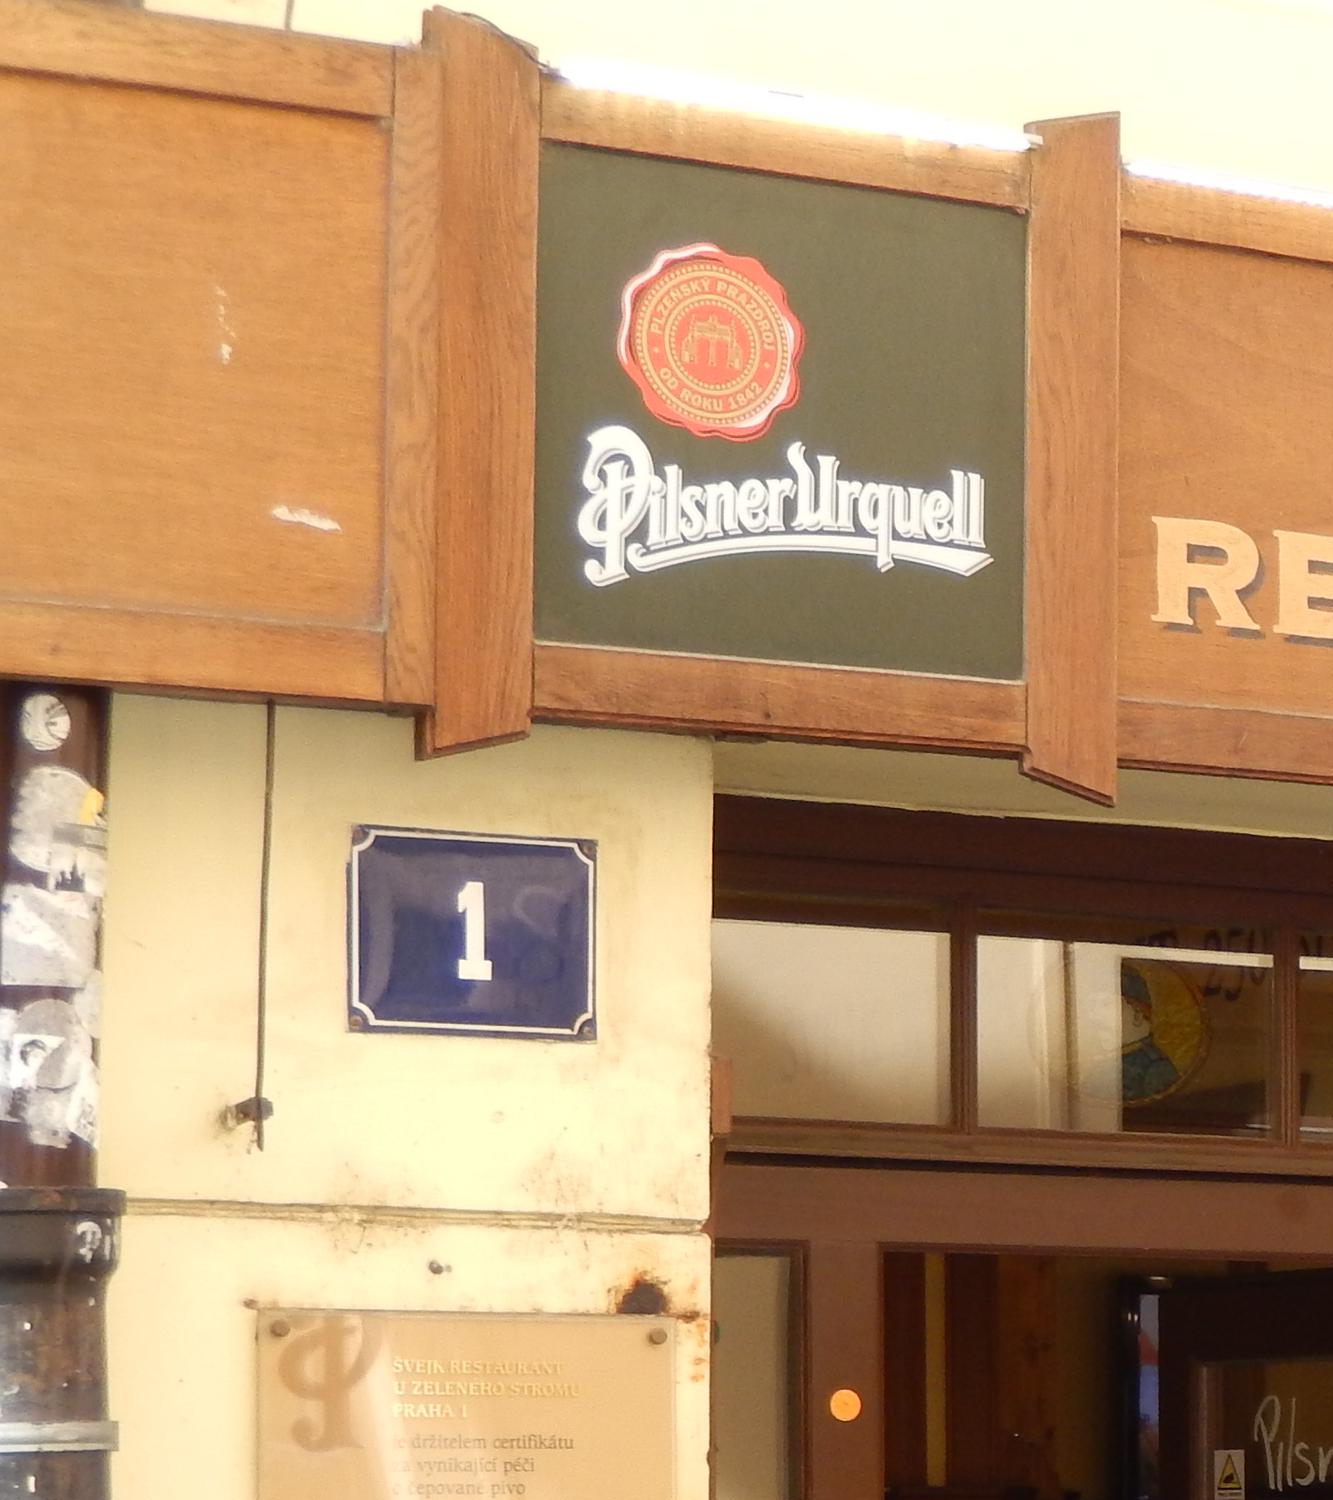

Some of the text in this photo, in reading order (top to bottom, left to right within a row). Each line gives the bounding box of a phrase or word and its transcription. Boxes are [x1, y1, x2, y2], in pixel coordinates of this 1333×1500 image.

[716, 280, 776, 351] PRAZDROJ
[659, 367, 763, 412] OD ROKU 1842
[578, 425, 986, 587] Pilsner Urquell
[457, 881, 493, 980] 1
[450, 1359, 564, 1376] RESTAURANT
[510, 1381, 582, 1399] STROMU
[392, 1403, 455, 1419] PRAHA
[411, 1434, 487, 1450] držitelem
[493, 1434, 574, 1450] certifikátu
[417, 1457, 497, 1477] vynikající
[503, 1457, 535, 1476] péči
[491, 1480, 526, 1498] pivo
